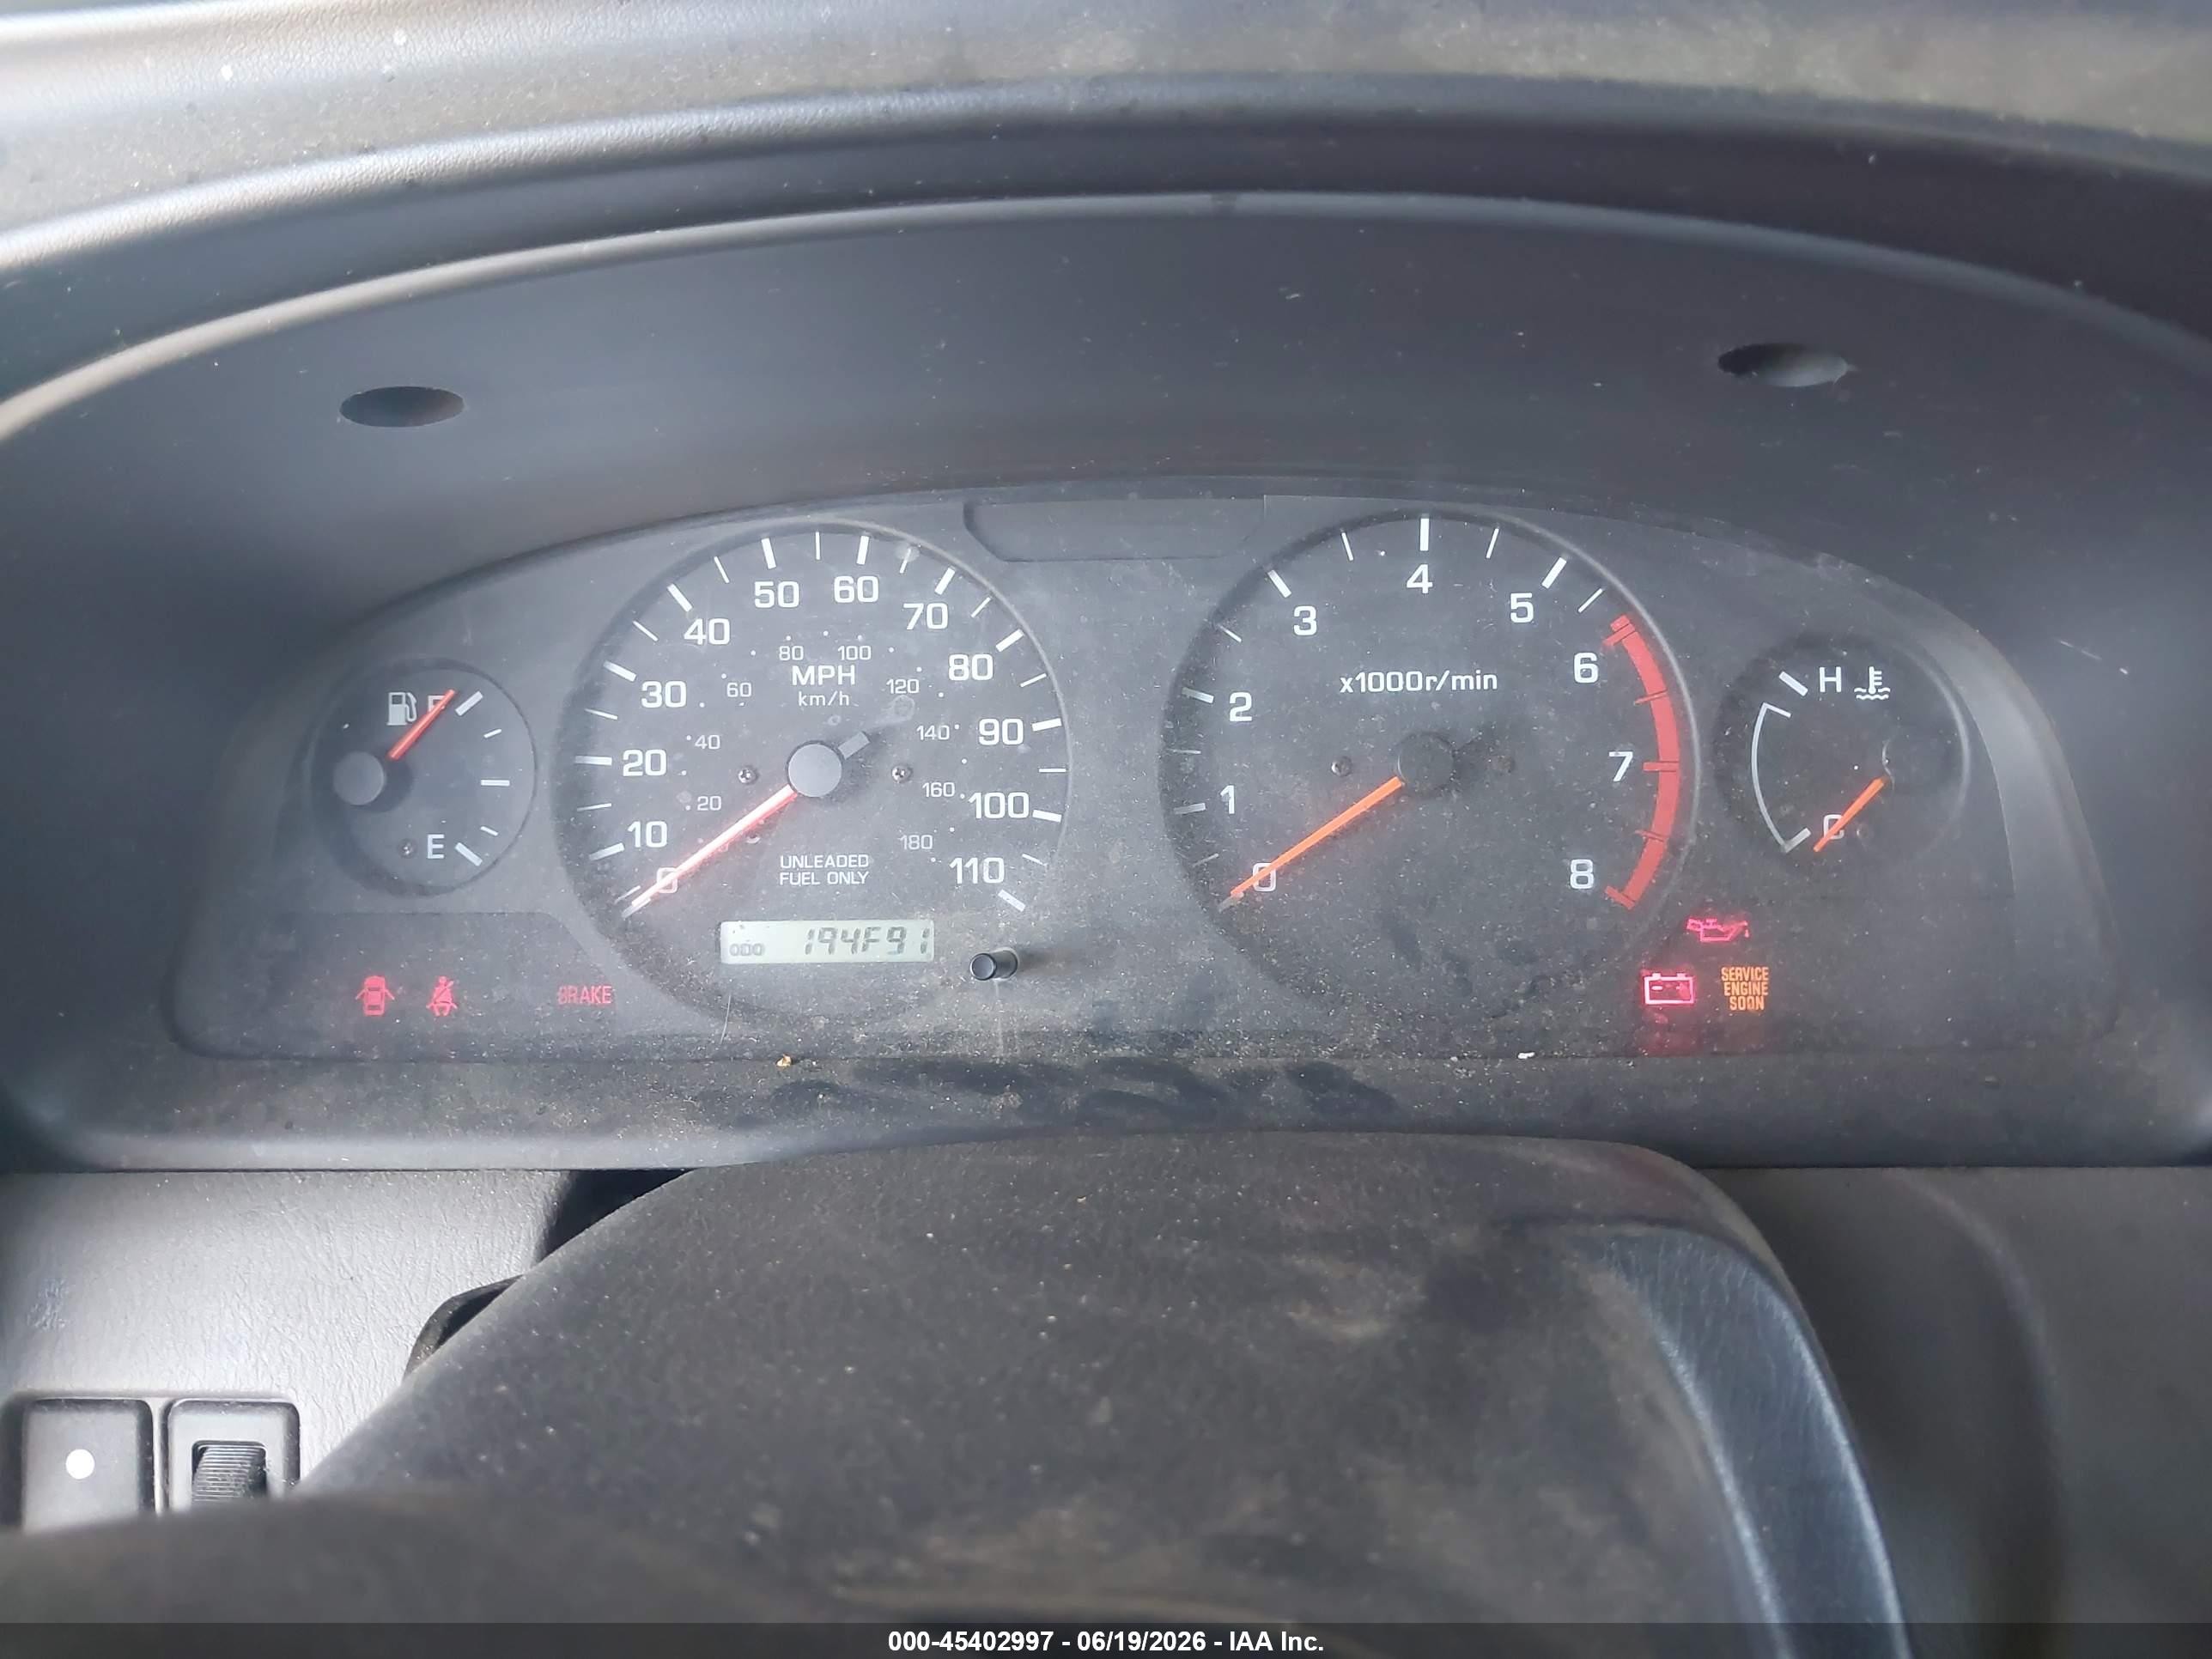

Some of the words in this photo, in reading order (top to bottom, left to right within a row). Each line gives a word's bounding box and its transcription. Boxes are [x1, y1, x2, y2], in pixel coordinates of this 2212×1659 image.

[833, 575, 879, 603] 60
[1407, 564, 1433, 593] 4
[754, 580, 799, 608] 50
[902, 603, 948, 629] 70
[1510, 592, 1534, 623] 5
[684, 618, 731, 644] 40
[1293, 605, 1317, 636] 3
[779, 645, 804, 660] 80
[837, 645, 872, 660] 100
[792, 665, 856, 685] MPH
[948, 653, 994, 681] 80
[1573, 653, 1599, 684] 6
[1819, 667, 1842, 692] H
[641, 681, 686, 708] 30
[726, 683, 752, 698] 60
[886, 678, 919, 694] 120
[1340, 670, 1498, 694] x1000r/min
[798, 690, 849, 708] km/h
[1229, 692, 1253, 721] 2
[694, 734, 720, 749] 40
[916, 725, 950, 740] 140
[978, 718, 1024, 744] 90
[623, 749, 666, 776] 20
[1609, 751, 1633, 782] 7
[922, 781, 955, 798] 160
[1220, 784, 1236, 814] 1
[697, 795, 722, 811] 20
[968, 792, 1030, 818] 100
[427, 834, 445, 859] E
[628, 821, 667, 847] 10
[899, 834, 933, 849] 180
[780, 854, 869, 868] UNLEADED
[949, 857, 1005, 884] 110
[780, 872, 821, 885] FUEL
[827, 871, 869, 885] ONLY
[1570, 860, 1594, 889] 8
[1721, 967, 1770, 981] SERVICE
[557, 985, 613, 1005] BRAKE
[1723, 981, 1769, 996] ENGINE
[1729, 996, 1765, 1011] SOON
